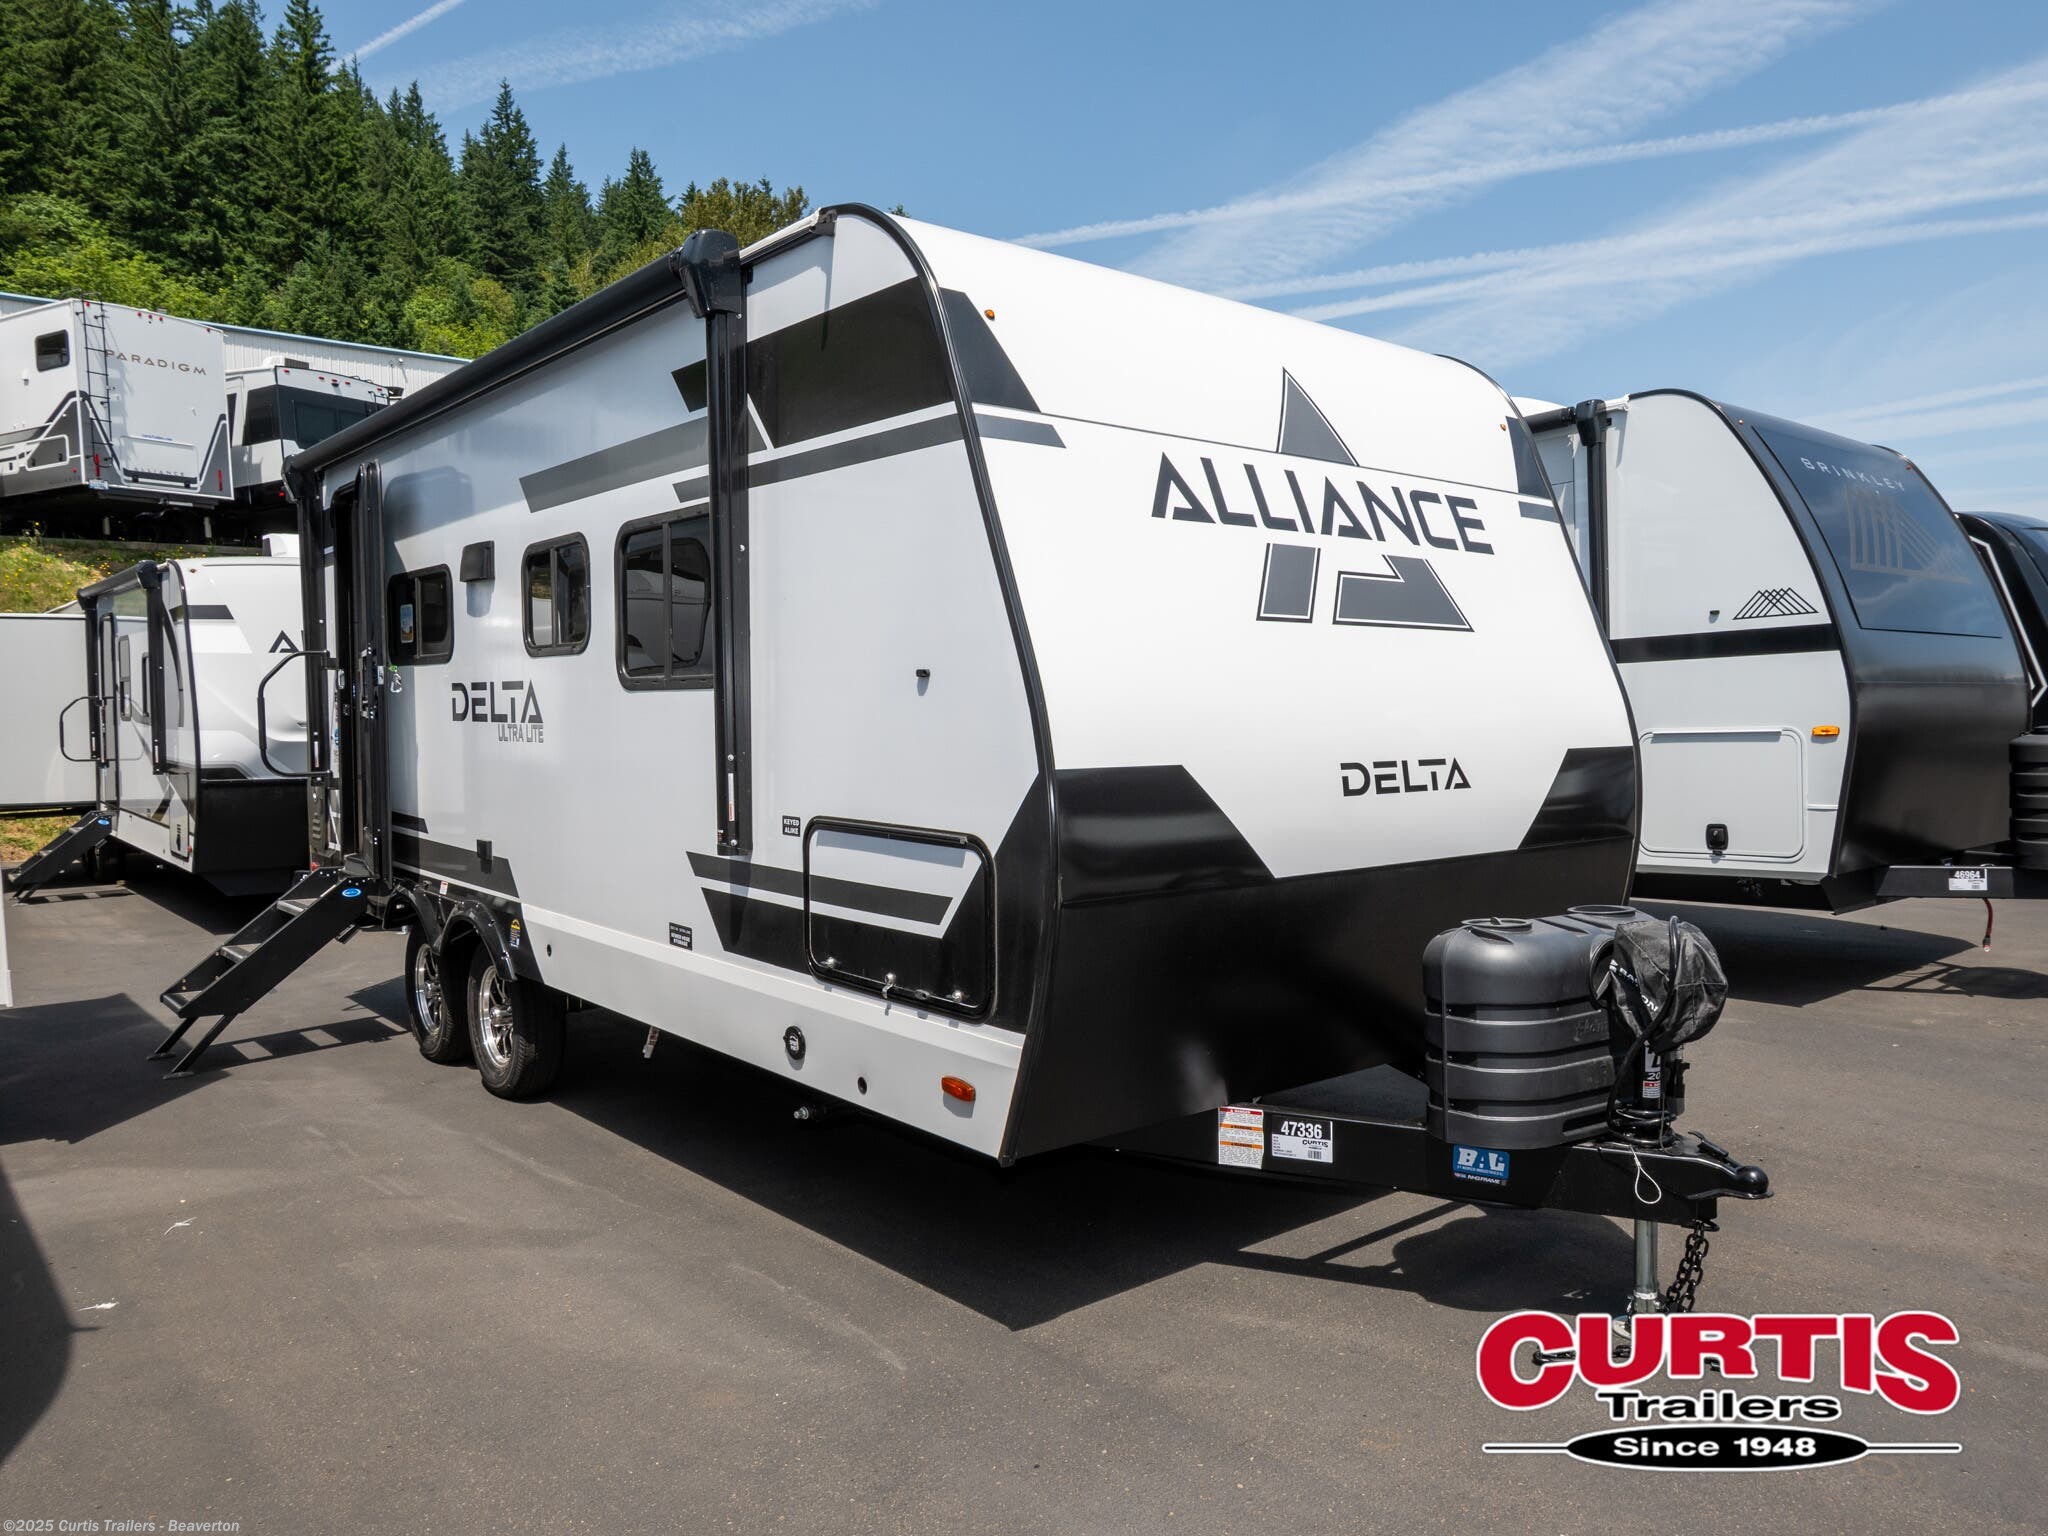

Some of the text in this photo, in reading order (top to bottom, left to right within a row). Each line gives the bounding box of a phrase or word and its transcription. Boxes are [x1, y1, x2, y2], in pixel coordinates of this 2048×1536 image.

[106, 349, 207, 375] PARADIGM
[1800, 457, 1905, 492] BRINKLEY
[1151, 452, 1495, 555] ALLIANCE
[451, 678, 543, 723] DELTA
[498, 723, 544, 743] ULTRA LITE
[1340, 757, 1472, 797] DELTA
[783, 818, 800, 827] KEYED
[784, 826, 799, 835] ALIKE
[1954, 870, 1980, 880] 46964
[1280, 1120, 1322, 1139] 47336
[1302, 1139, 1329, 1148] CURTIS
[1457, 1147, 1505, 1172] BAL
